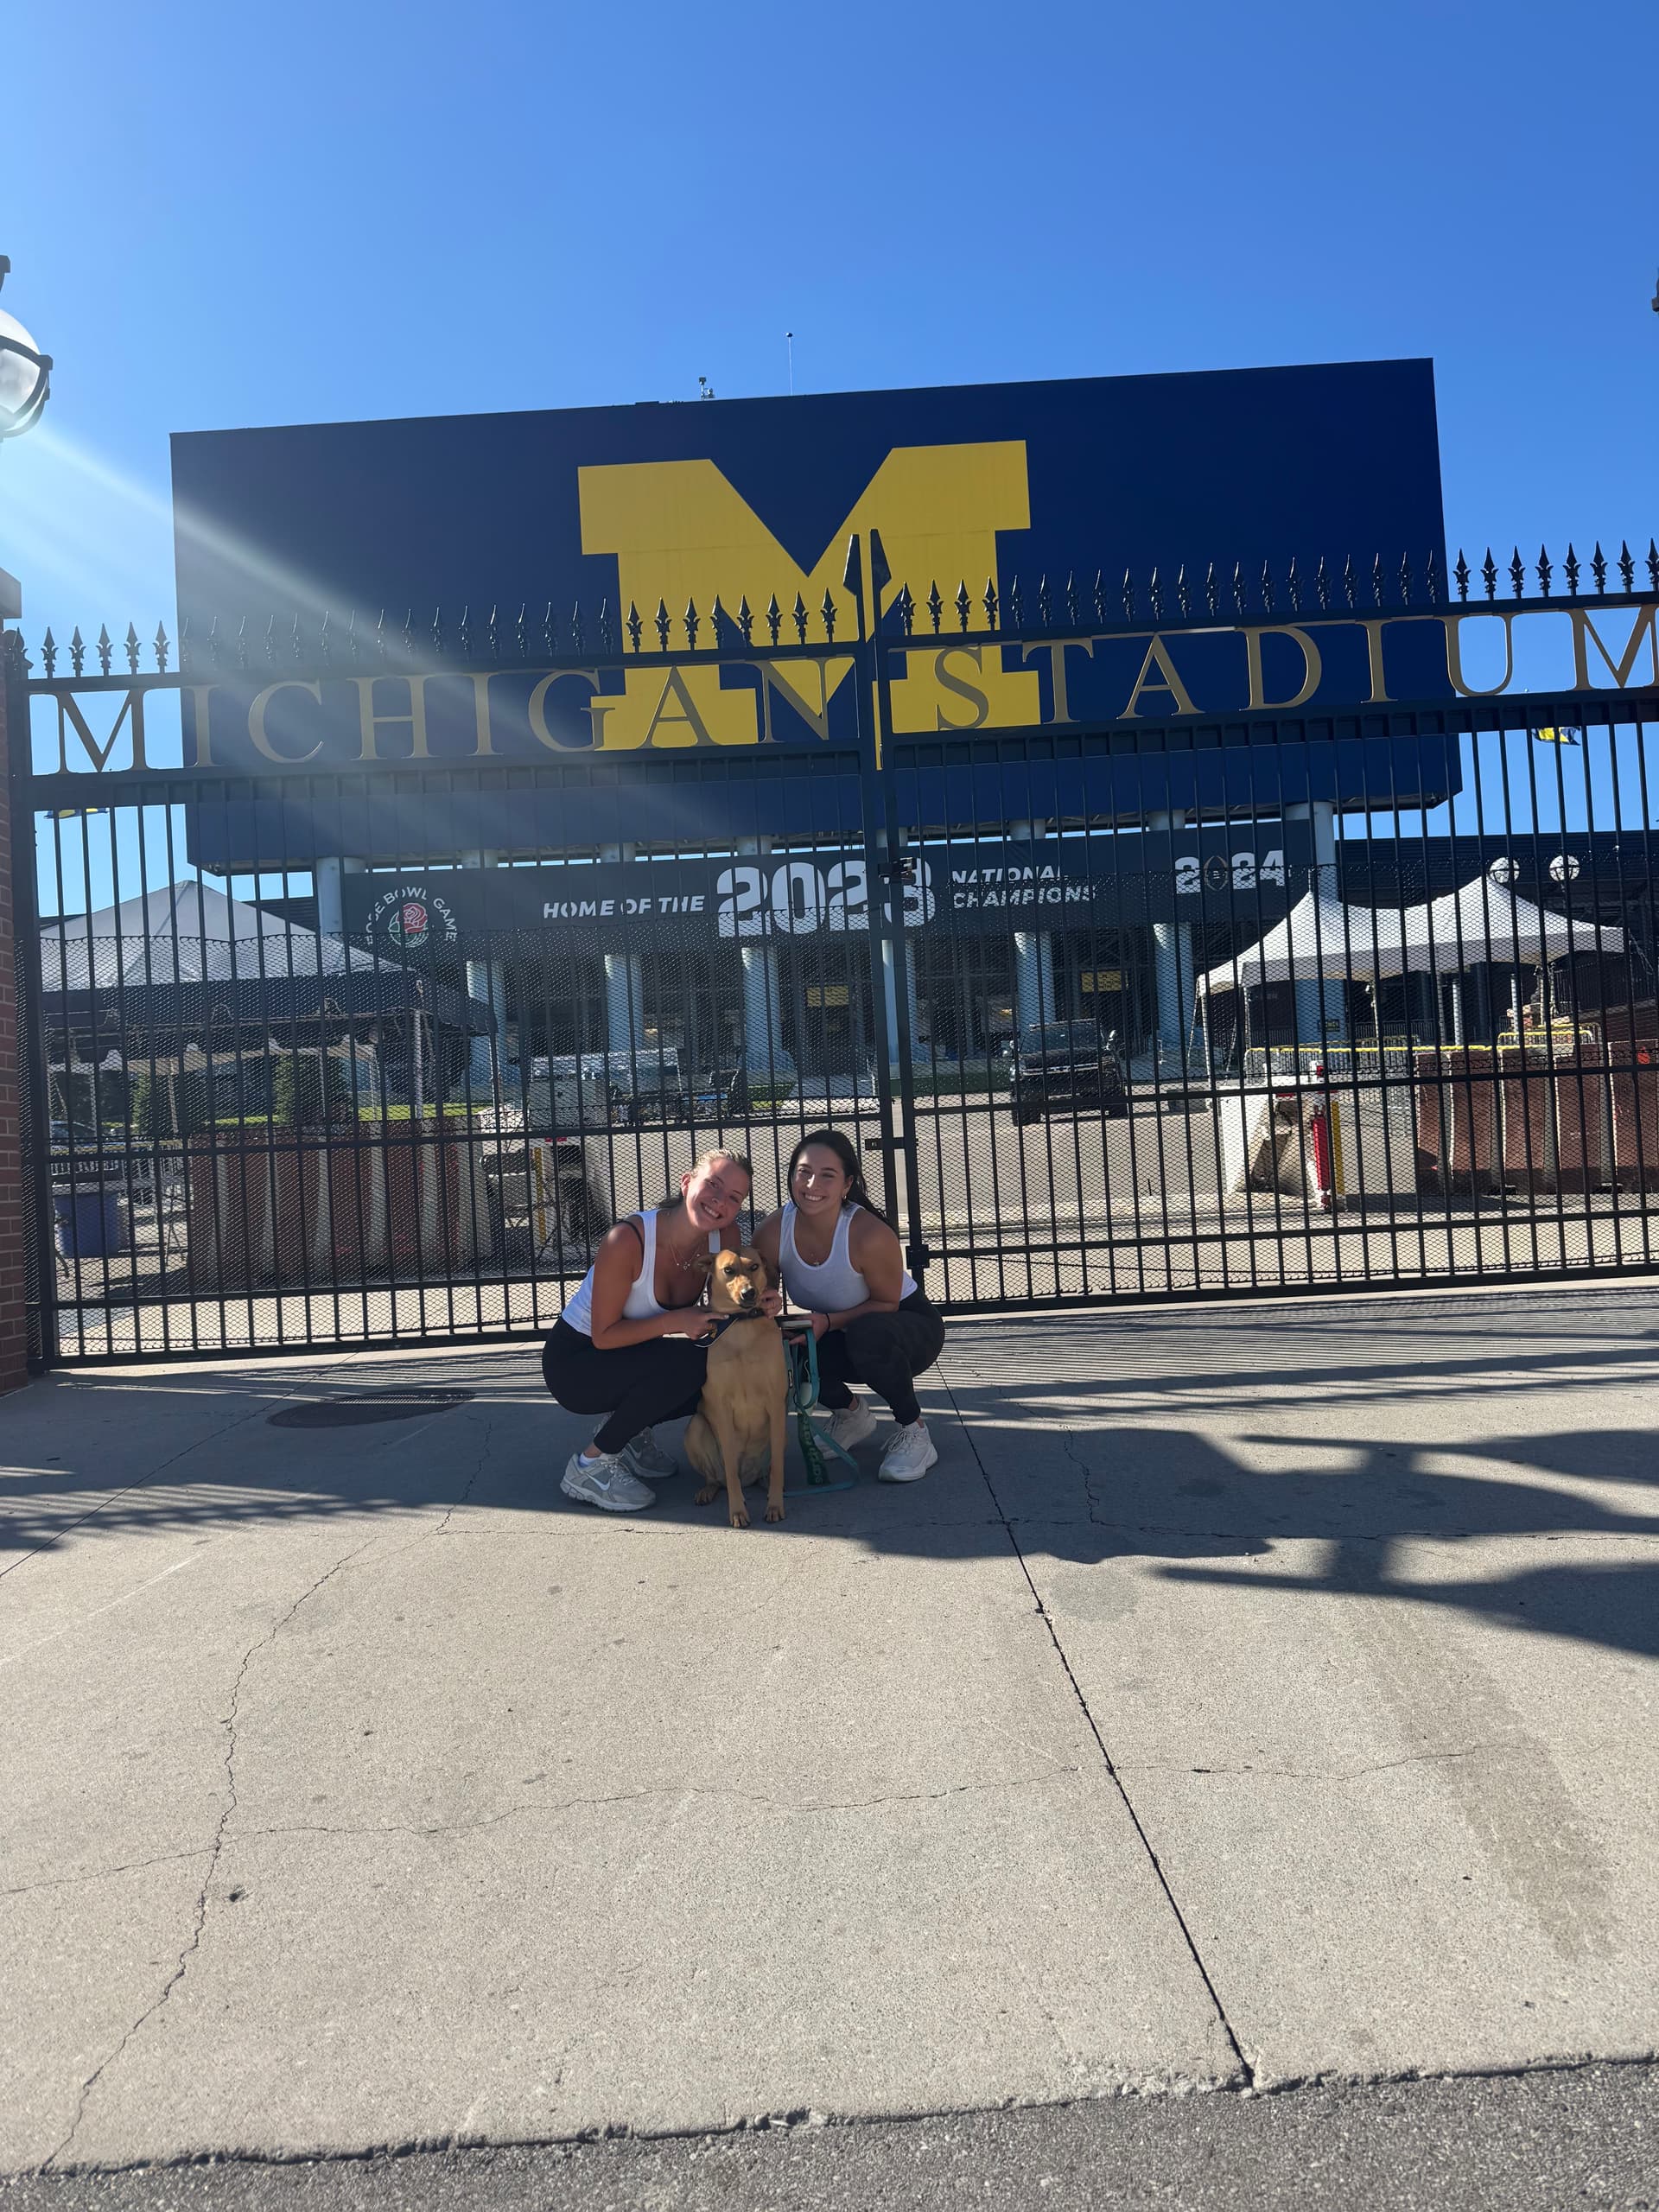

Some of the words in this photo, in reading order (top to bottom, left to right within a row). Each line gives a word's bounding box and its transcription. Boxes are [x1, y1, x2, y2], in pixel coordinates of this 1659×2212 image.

[578, 440, 1031, 771] M
[43, 654, 851, 775] MICHIGAN
[934, 604, 1659, 731] STADIUM
[433, 898, 458, 942] GAME
[543, 899, 615, 918] HOME
[620, 899, 652, 915] OF
[658, 895, 706, 913] THE
[716, 858, 936, 938] 2023
[953, 885, 1096, 908] CHAMPIONS
